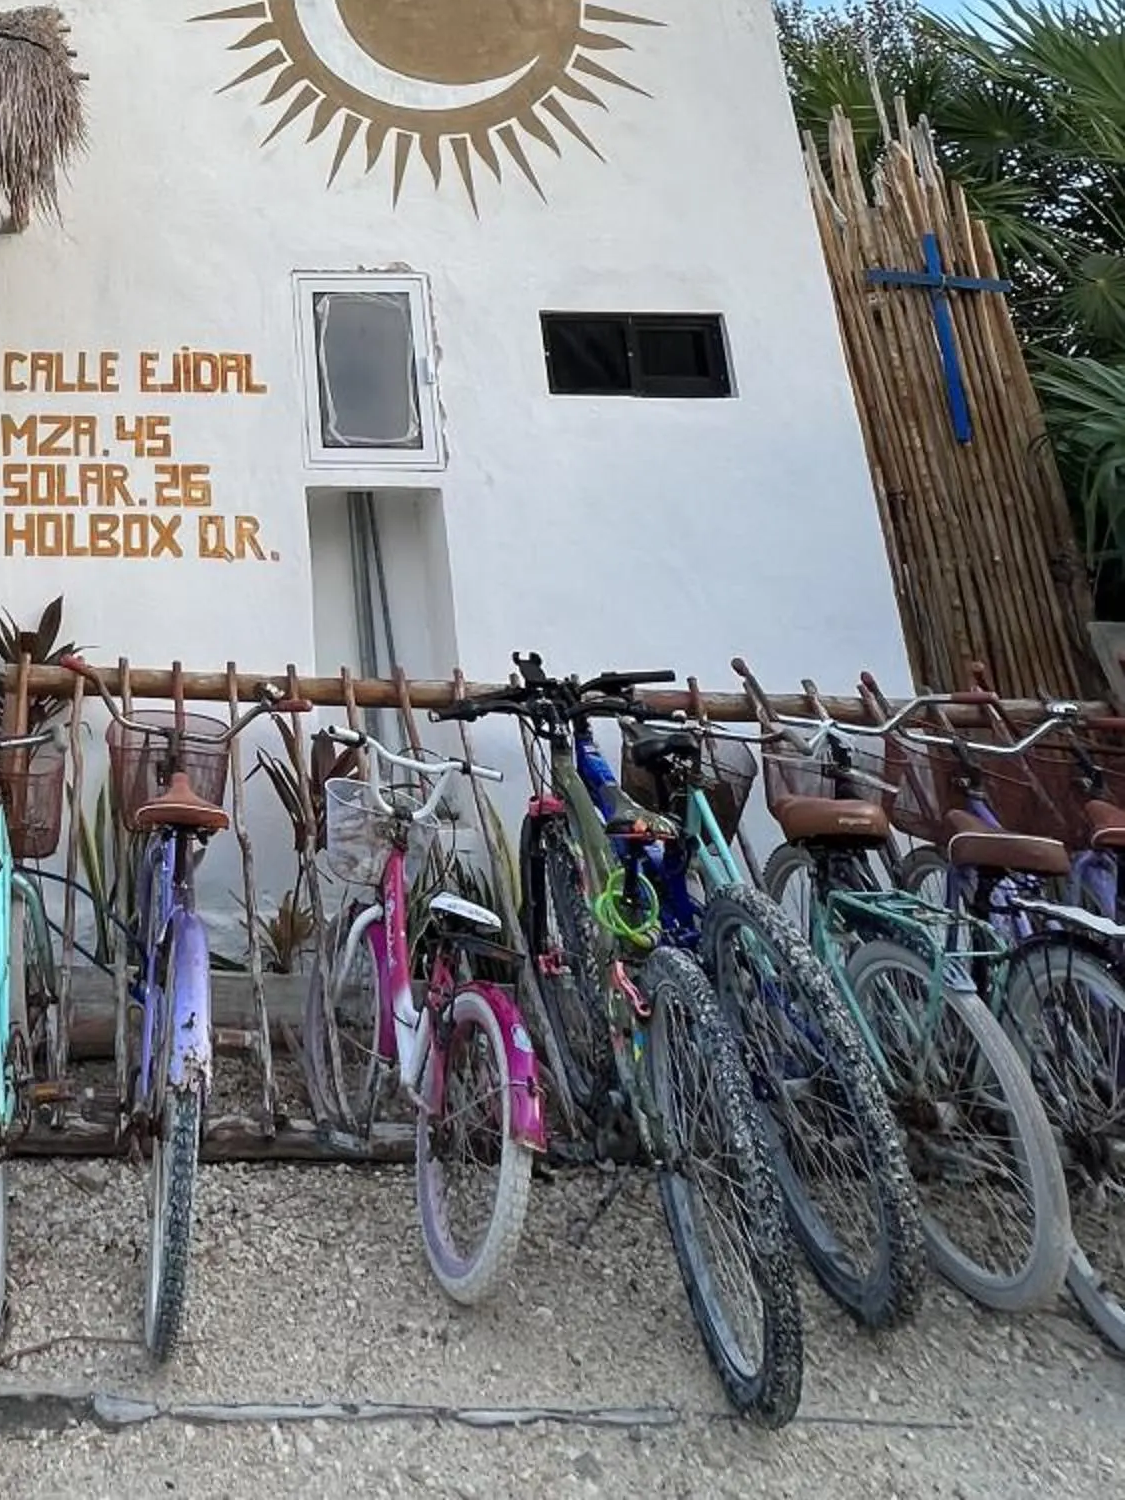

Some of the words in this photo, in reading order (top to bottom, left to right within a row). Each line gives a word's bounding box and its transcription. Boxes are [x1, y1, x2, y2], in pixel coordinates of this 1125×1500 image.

[3, 351, 120, 393] CALLE
[115, 415, 172, 458] 45
[4, 513, 184, 558] HOLBOX
